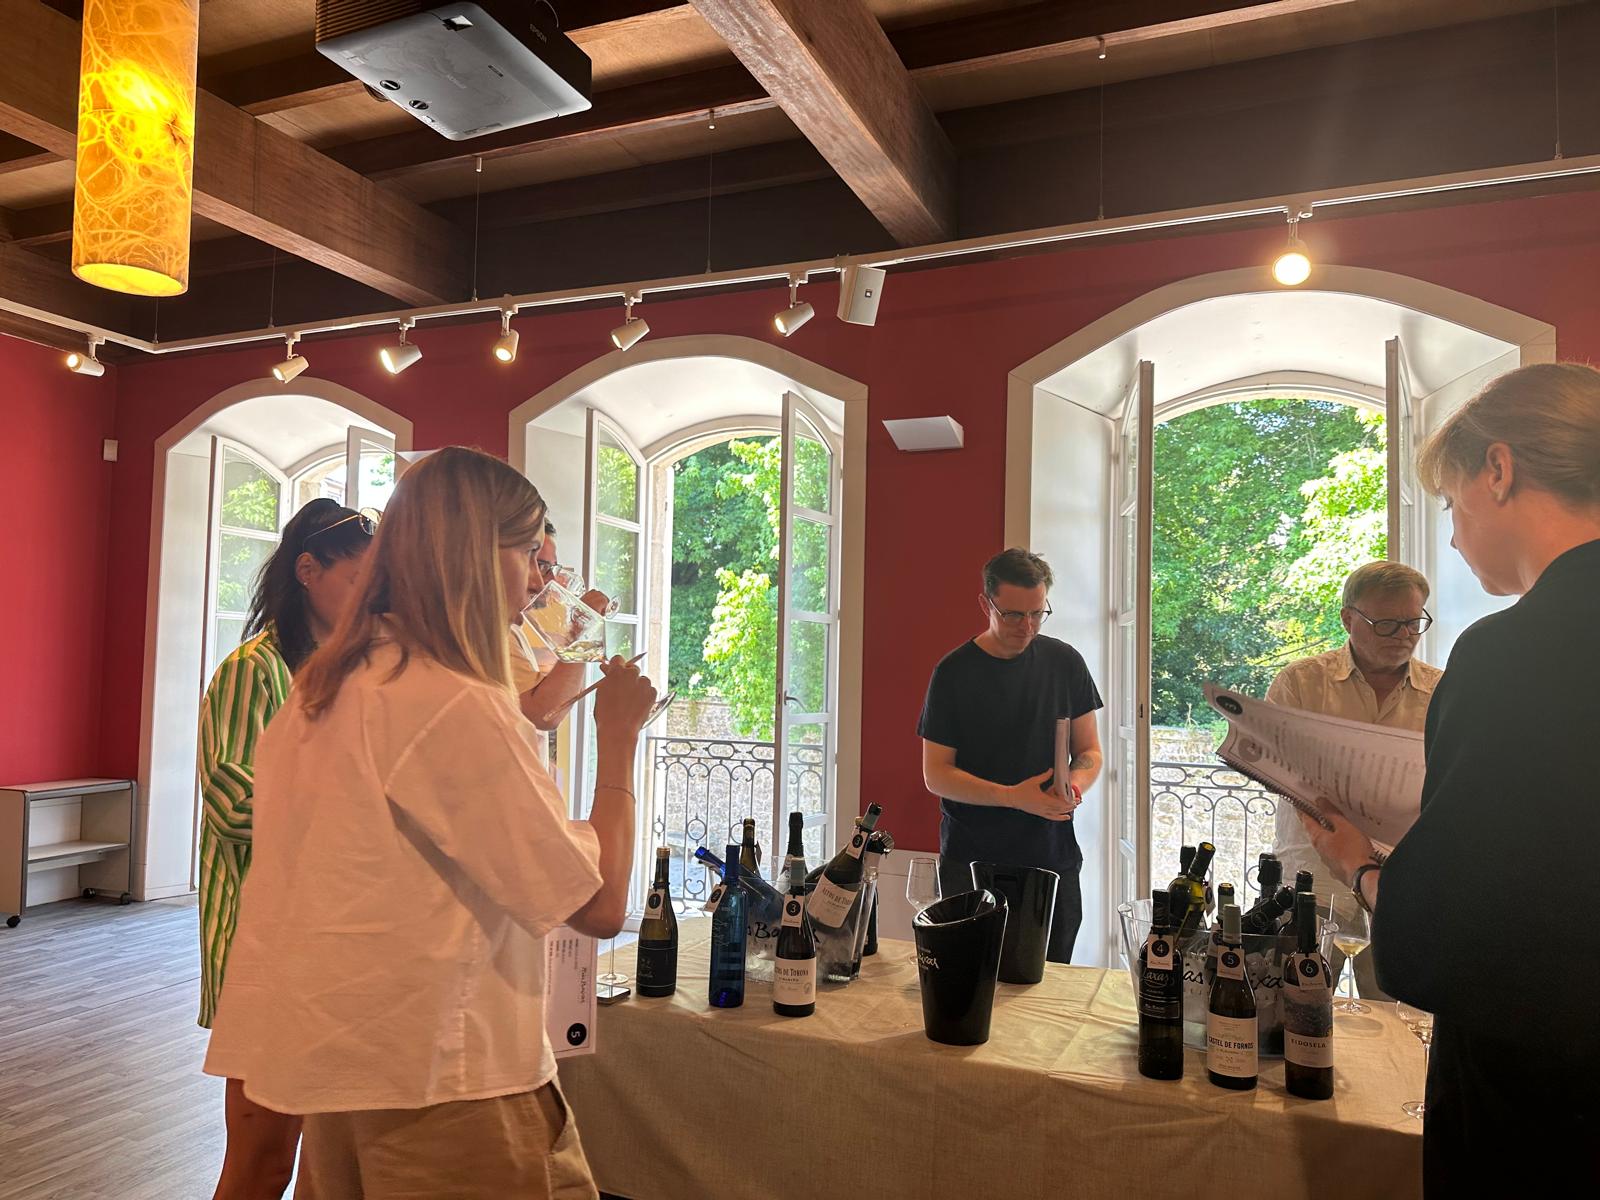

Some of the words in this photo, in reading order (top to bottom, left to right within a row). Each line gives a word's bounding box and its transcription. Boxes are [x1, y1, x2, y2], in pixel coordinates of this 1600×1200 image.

[790, 904, 797, 913] 3
[1156, 943, 1164, 954] 4
[1227, 954, 1234, 965] 5
[1305, 961, 1313, 974] 6
[571, 1030, 580, 1039] 5
[1225, 1041, 1233, 1049] DE
